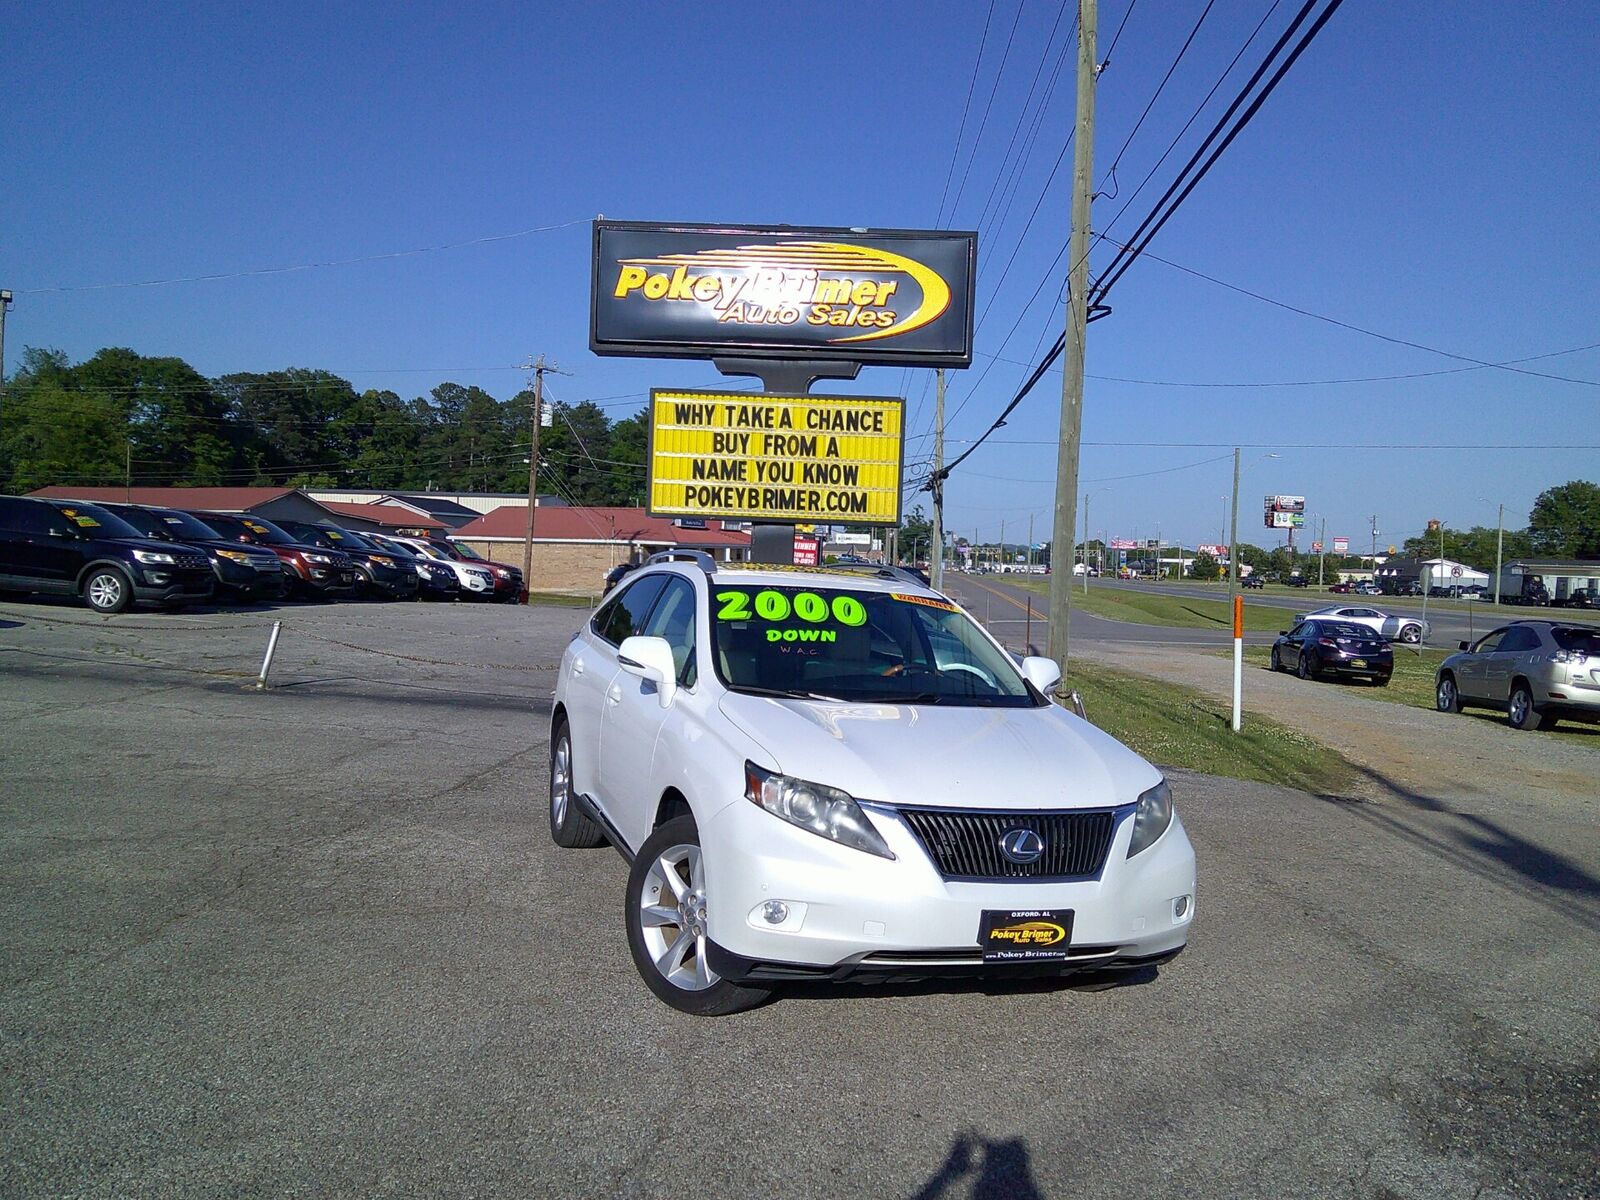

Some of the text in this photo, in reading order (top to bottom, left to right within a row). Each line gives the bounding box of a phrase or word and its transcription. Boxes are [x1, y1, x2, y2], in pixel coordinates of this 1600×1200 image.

[614, 265, 897, 310] Pokey Brimer
[720, 302, 897, 328] Auto Sales
[675, 404, 884, 432] WHY TAKE A CHANCE
[713, 433, 839, 458] BUY FROM A
[692, 459, 859, 486] NAME YOU KNOW
[684, 485, 868, 513] POKEYBRIMER.COM
[716, 591, 868, 627] 2000
[766, 629, 837, 643] DOWN
[990, 929, 1054, 939] Pokey Brimer
